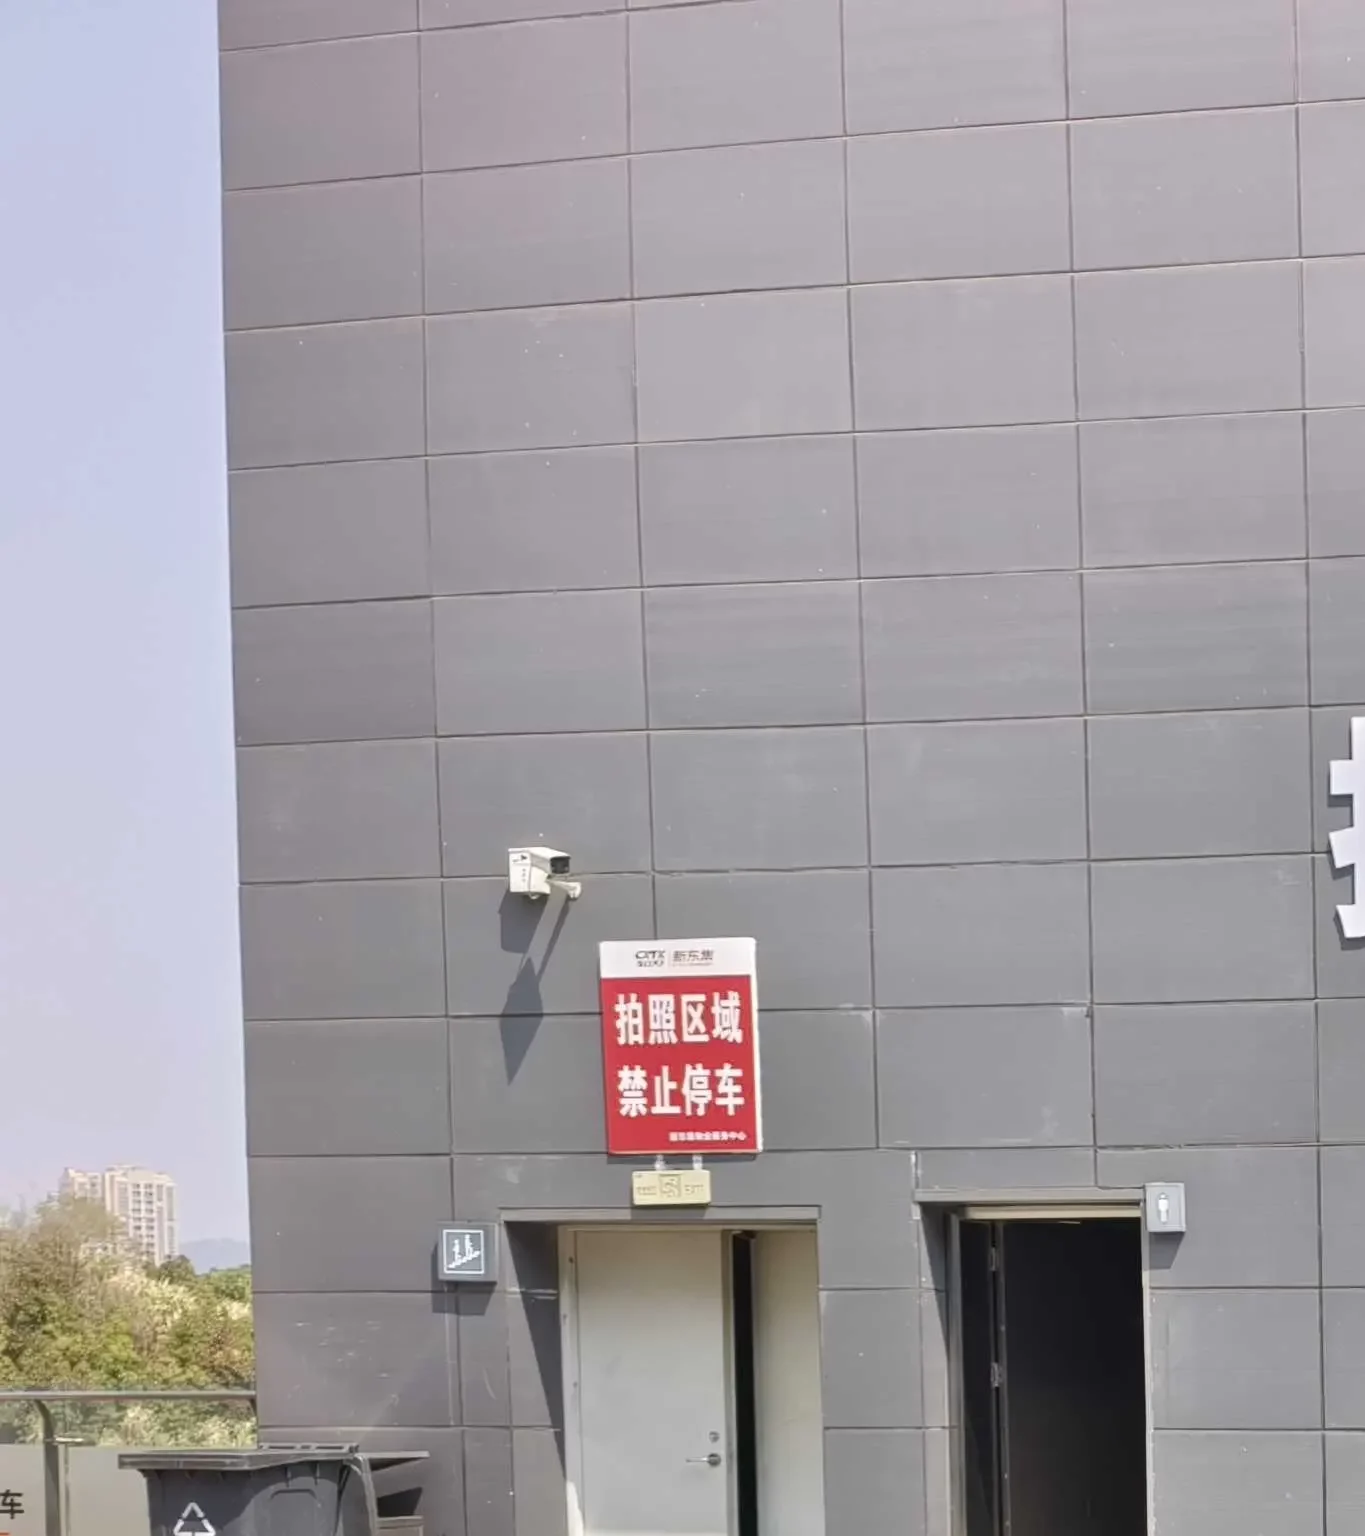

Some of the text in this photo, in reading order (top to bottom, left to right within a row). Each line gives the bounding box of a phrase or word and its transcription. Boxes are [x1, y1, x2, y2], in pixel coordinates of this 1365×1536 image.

[614, 991, 744, 1046] 拍照区域
[616, 1062, 746, 1118] 禁止停车
